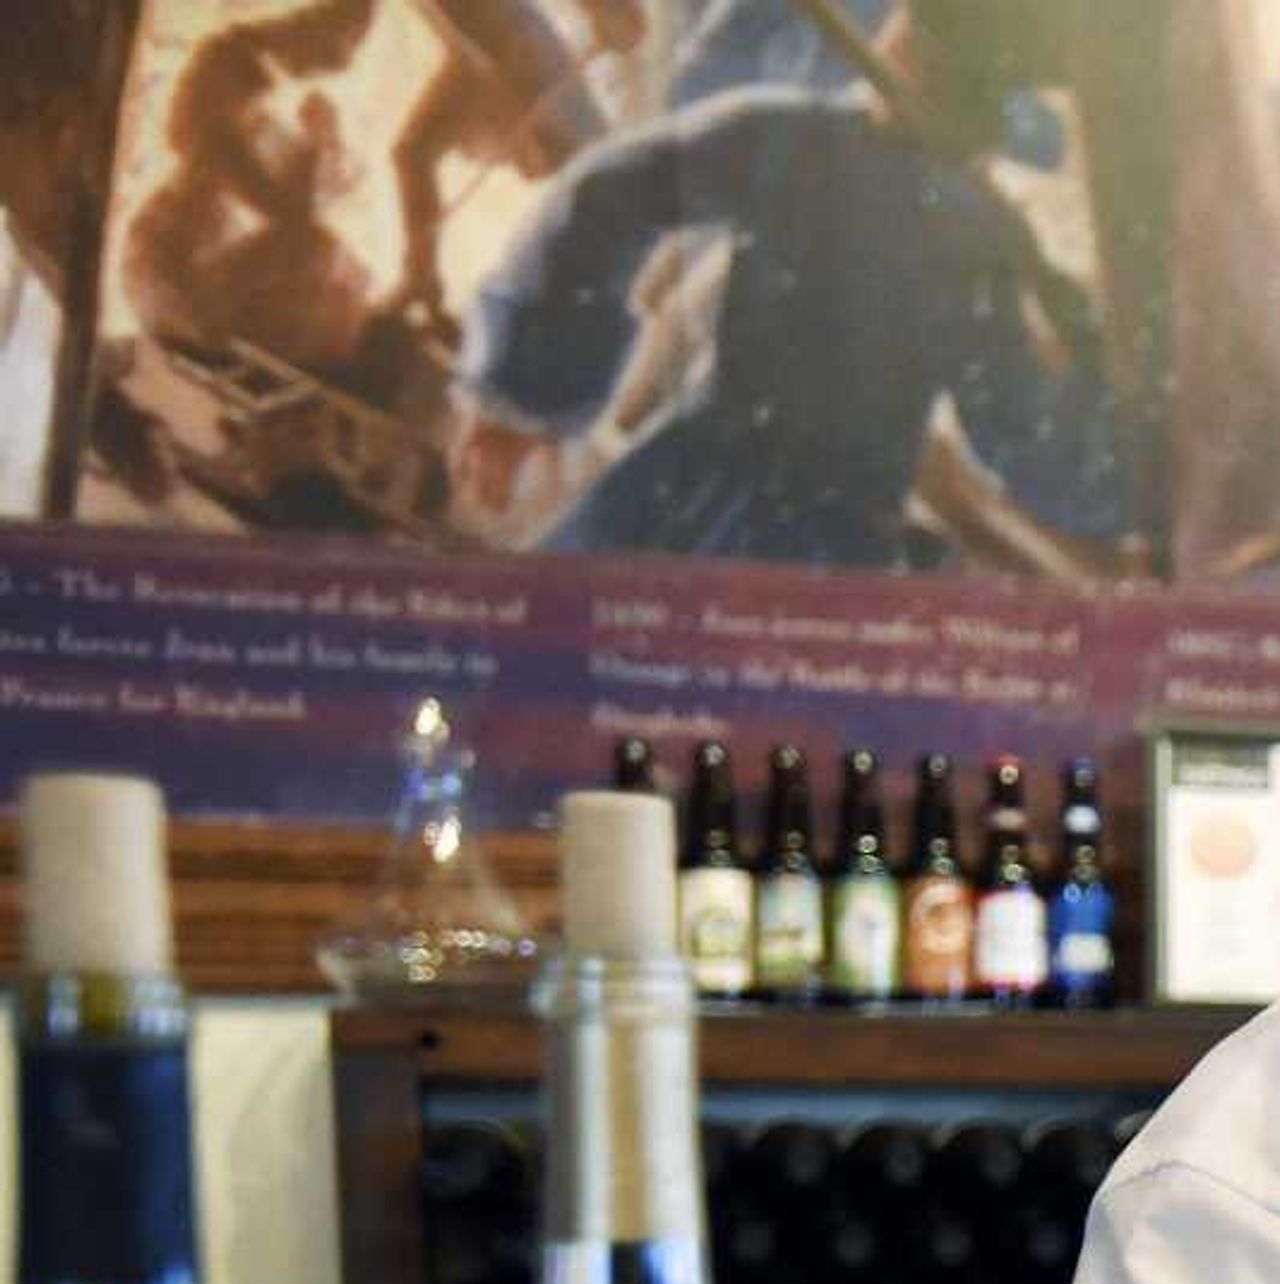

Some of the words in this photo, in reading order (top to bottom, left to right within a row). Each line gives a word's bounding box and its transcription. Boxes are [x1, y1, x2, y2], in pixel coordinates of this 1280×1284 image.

[52, 568, 119, 599] The
[310, 581, 343, 613] of
[350, 584, 400, 615] the
[245, 635, 300, 665] and
[175, 683, 304, 720] England
